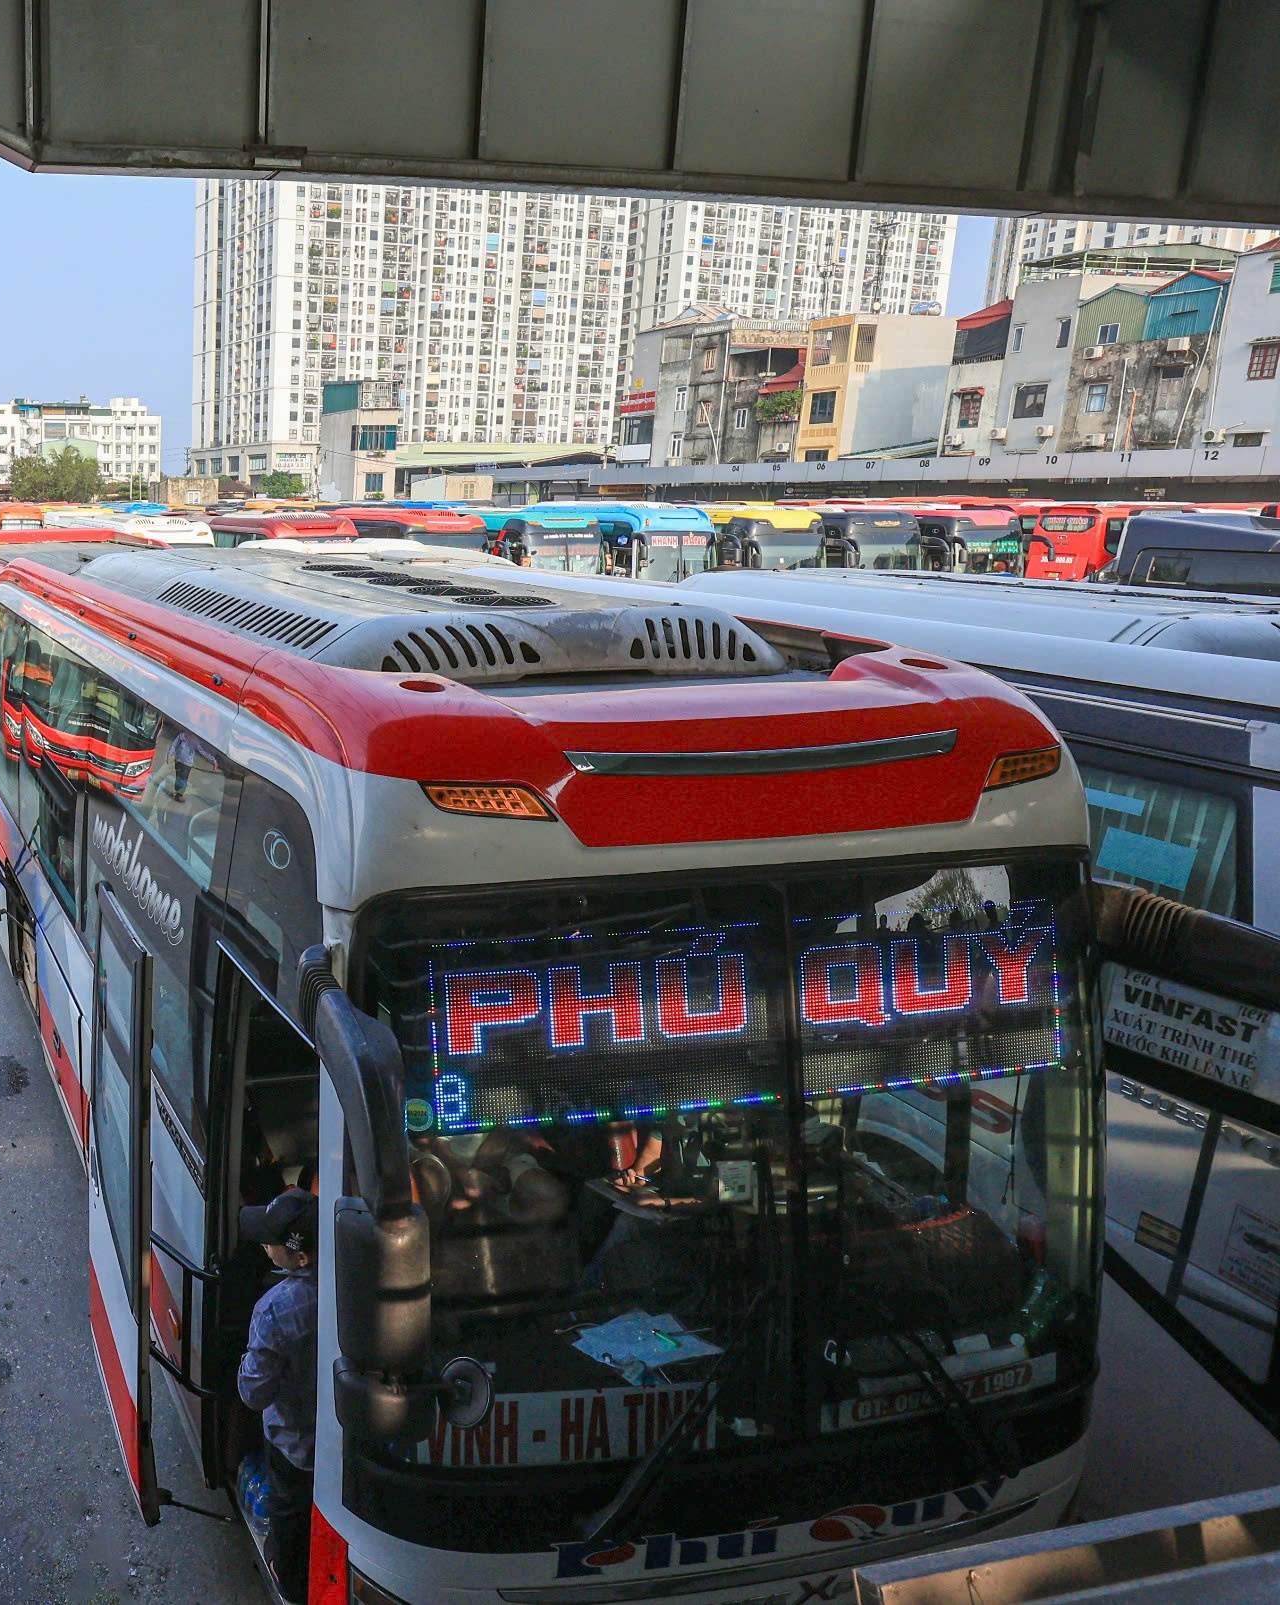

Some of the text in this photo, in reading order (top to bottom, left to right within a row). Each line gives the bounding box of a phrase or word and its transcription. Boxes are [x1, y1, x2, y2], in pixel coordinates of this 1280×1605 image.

[1044, 455, 1058, 465] 10
[1120, 453, 1132, 463] 11
[1203, 450, 1220, 461] 12
[816, 462, 826, 471] 06
[865, 461, 876, 470] 07
[919, 460, 930, 468] 08
[978, 457, 991, 466] 09
[772, 463, 781, 472] 05
[445, 906, 1054, 1055] PHÚ QUÝ
[1124, 983, 1260, 1044] VINFAST
[1110, 1008, 1258, 1071] XUẤT TRÌNH THẺ
[1106, 1026, 1254, 1090] TRƯỚC KHI LÊN XE
[560, 1386, 612, 1461] HÀ
